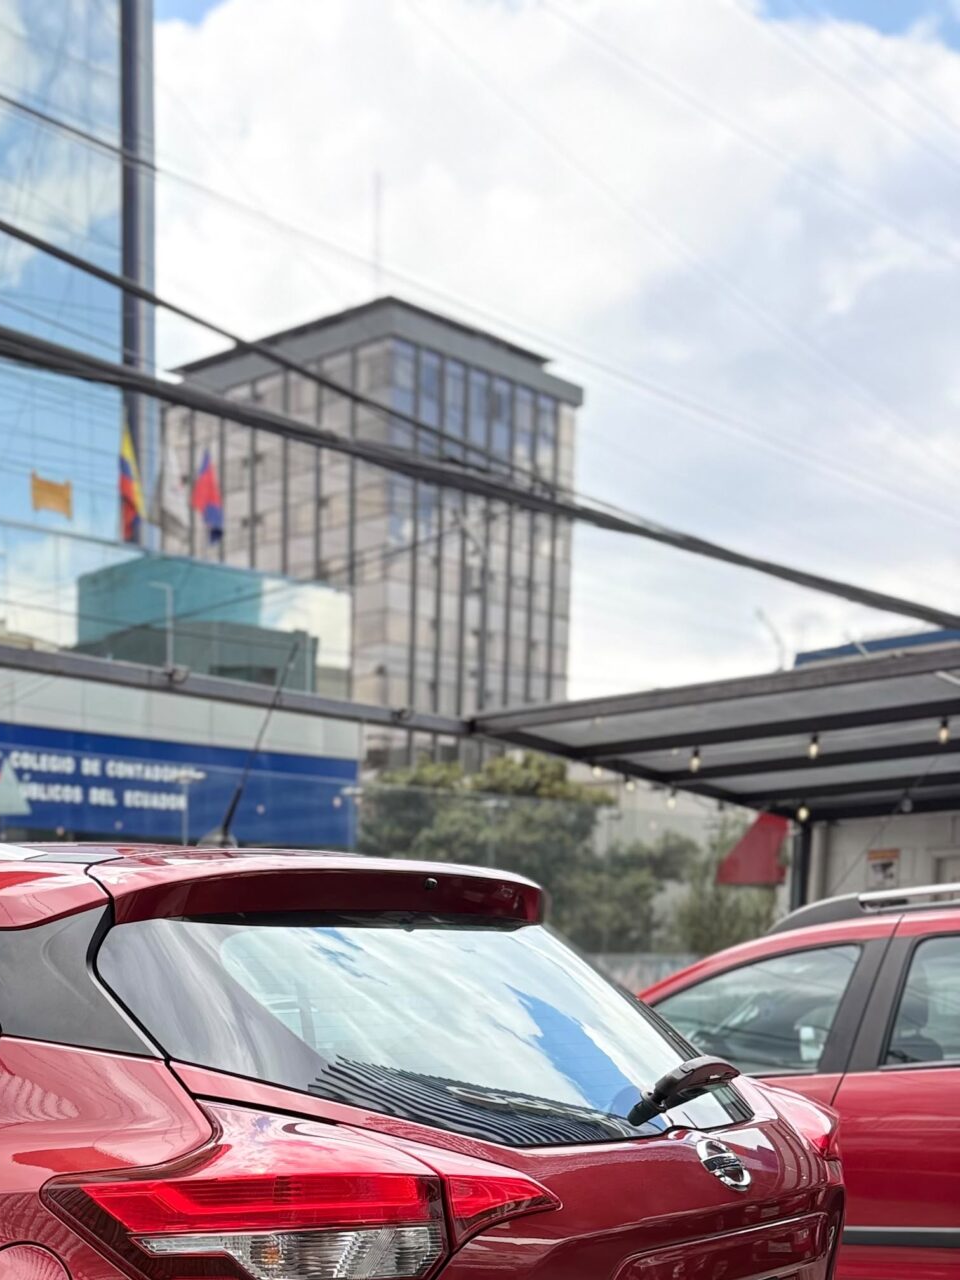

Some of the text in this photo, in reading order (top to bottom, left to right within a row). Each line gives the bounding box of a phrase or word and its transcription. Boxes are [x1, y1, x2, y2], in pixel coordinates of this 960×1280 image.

[8, 751, 76, 775] COLEGIO
[80, 758, 102, 777] DE
[89, 786, 117, 808] DEL
[123, 789, 187, 811] ECUADOR
